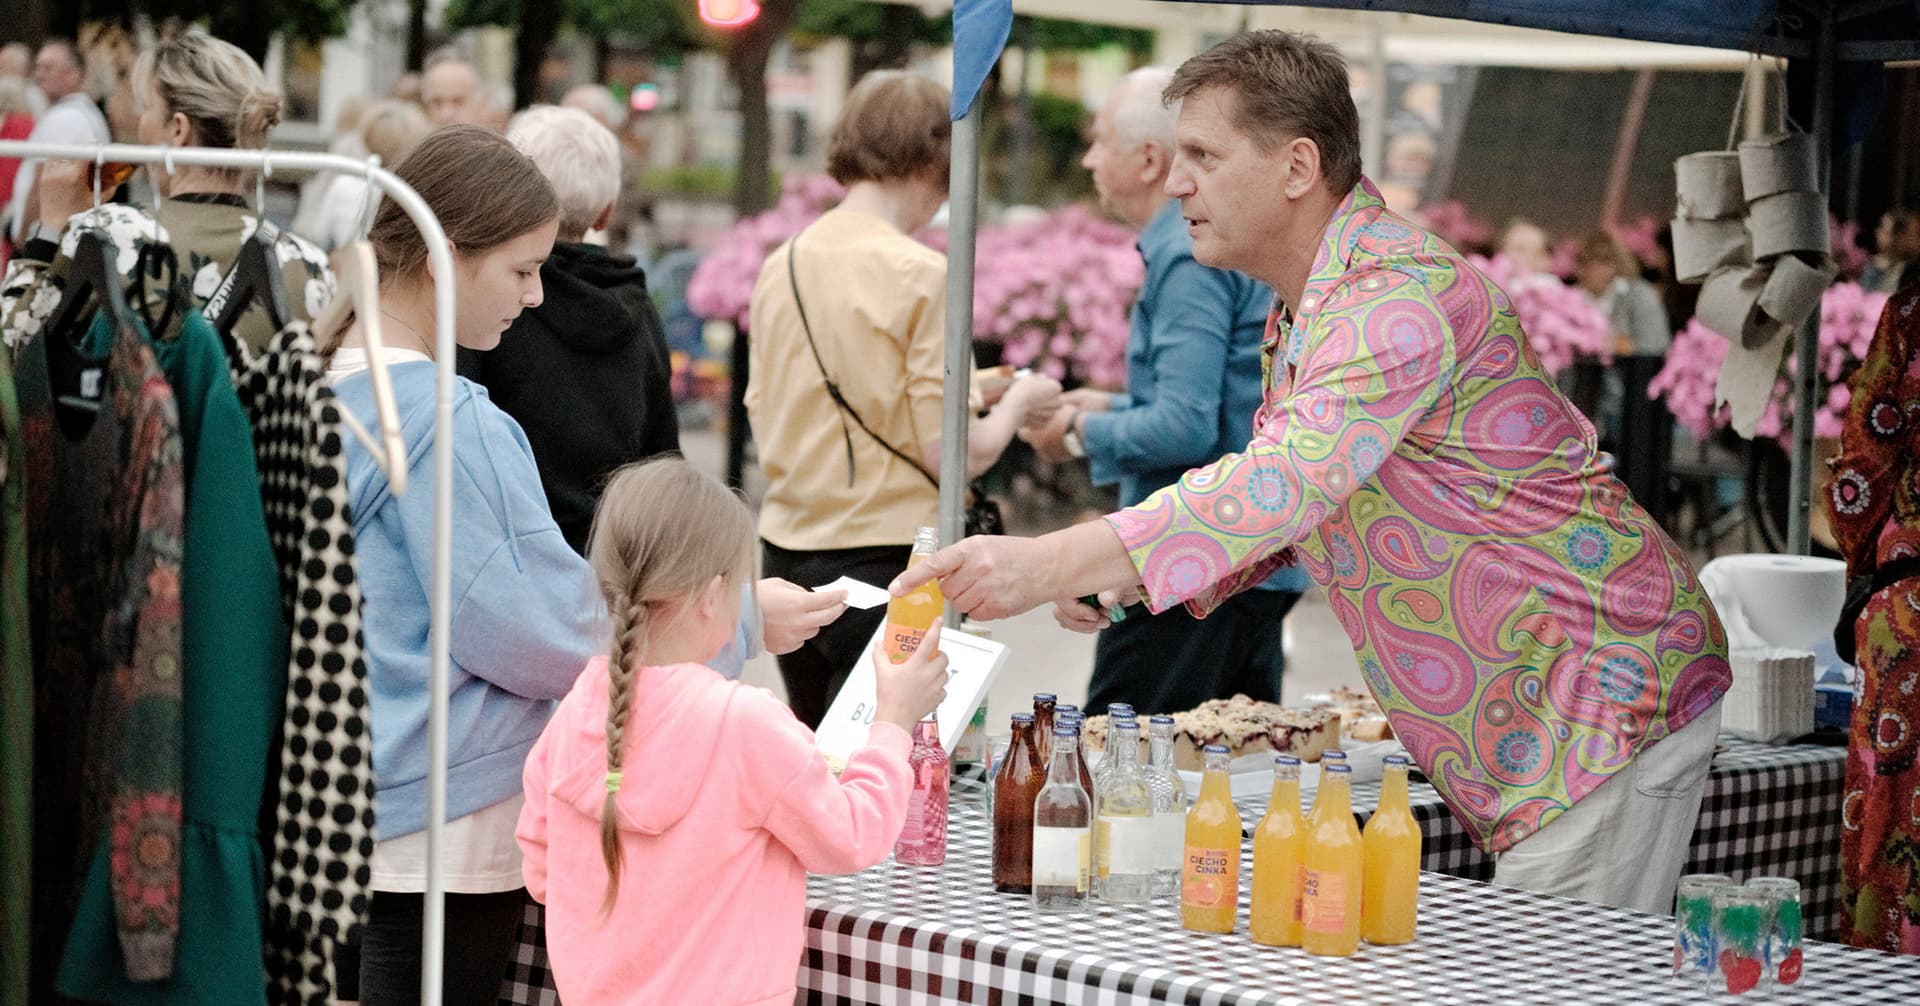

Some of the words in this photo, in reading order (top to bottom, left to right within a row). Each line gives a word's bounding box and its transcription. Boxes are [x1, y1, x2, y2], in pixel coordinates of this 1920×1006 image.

[895, 633, 921, 645] CIEC
[900, 643, 918, 652] CIN
[851, 702, 875, 725] BU
[1190, 855, 1227, 866] CIECHO
[1195, 865, 1227, 874] CINKA
